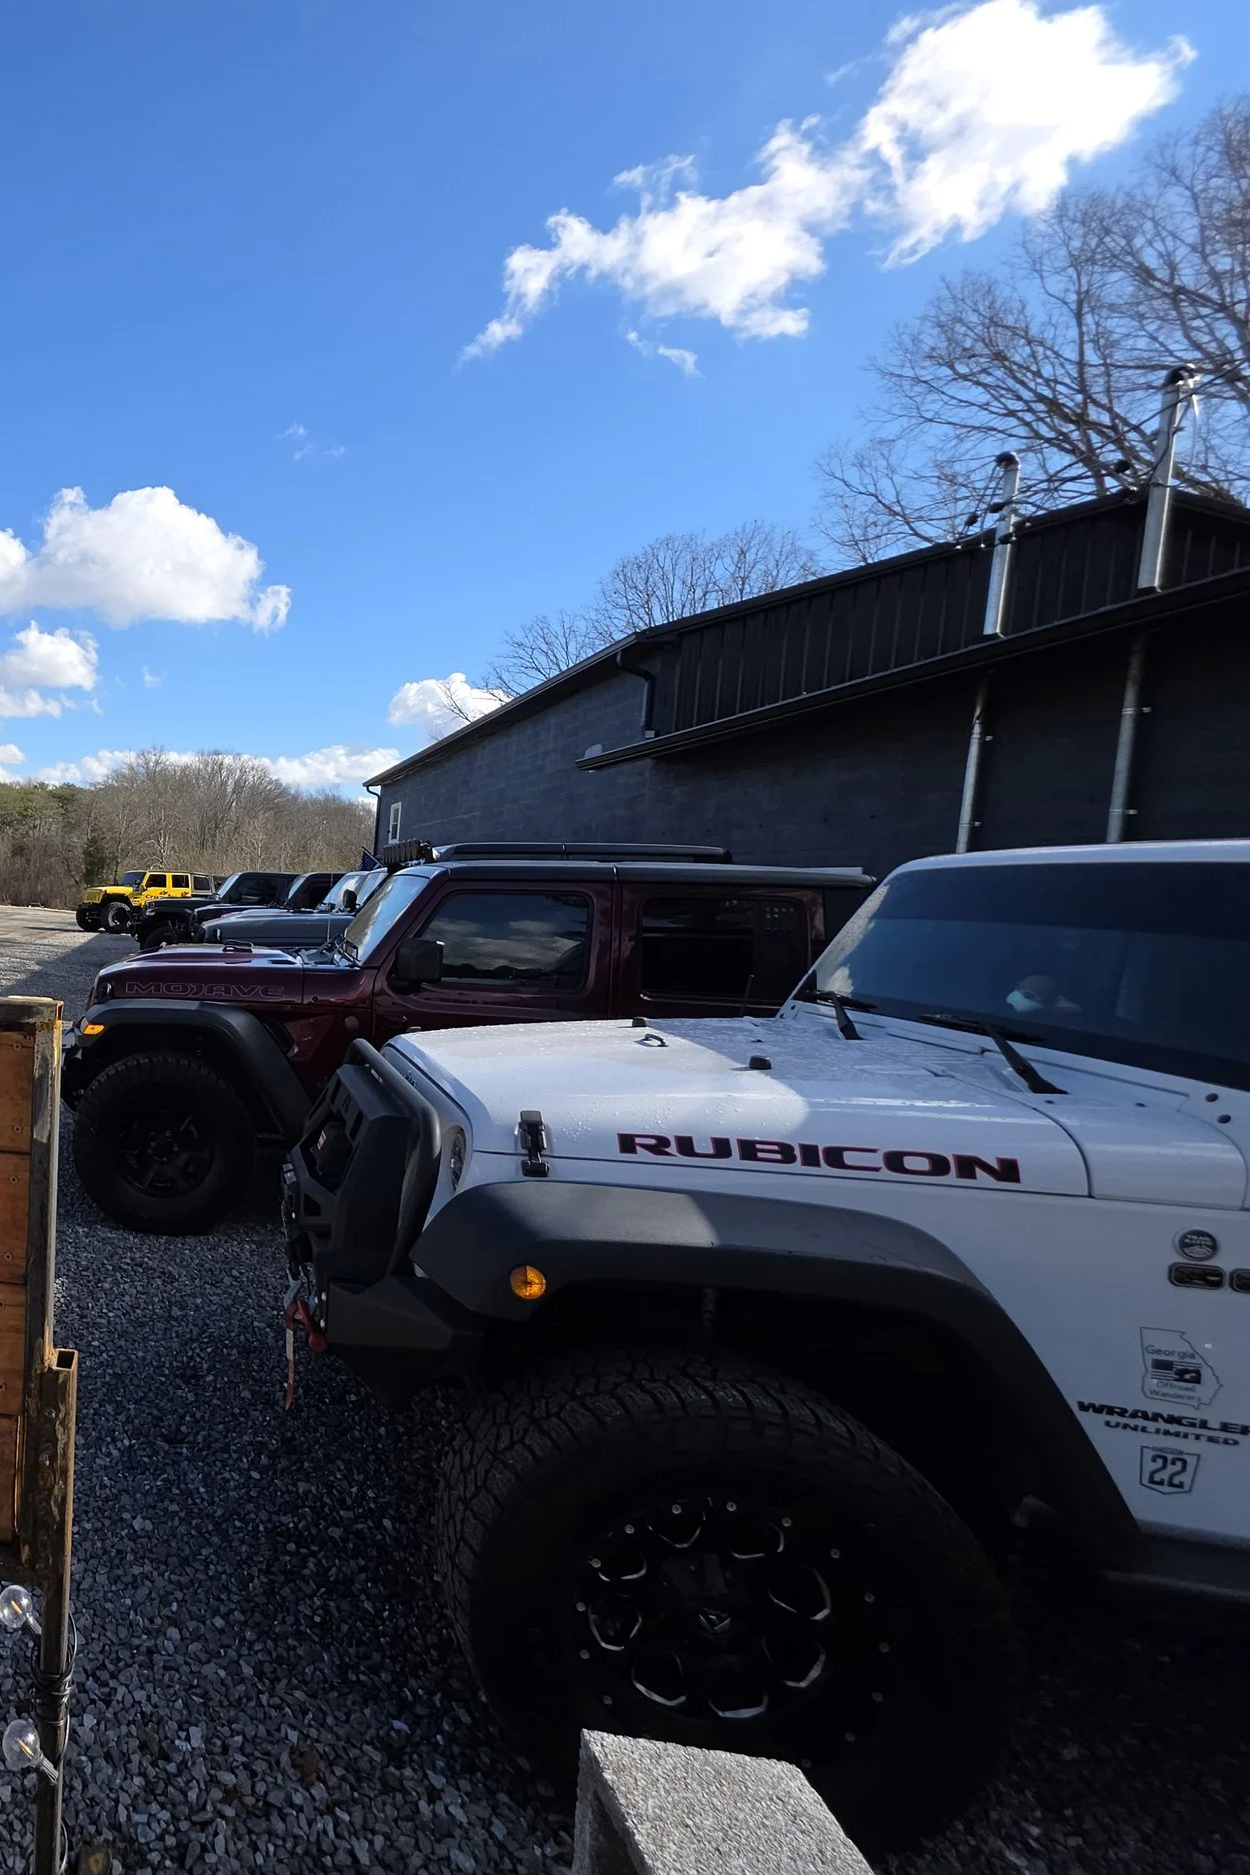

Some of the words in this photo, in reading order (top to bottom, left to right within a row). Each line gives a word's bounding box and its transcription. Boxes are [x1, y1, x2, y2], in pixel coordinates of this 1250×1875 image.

[125, 981, 285, 998] MOJAVE
[616, 1132, 1022, 1184] RUBICON
[1145, 1344, 1196, 1360] Georgia
[1103, 1419, 1240, 1446] UNLIMITED
[1148, 1454, 1188, 1490] 22
